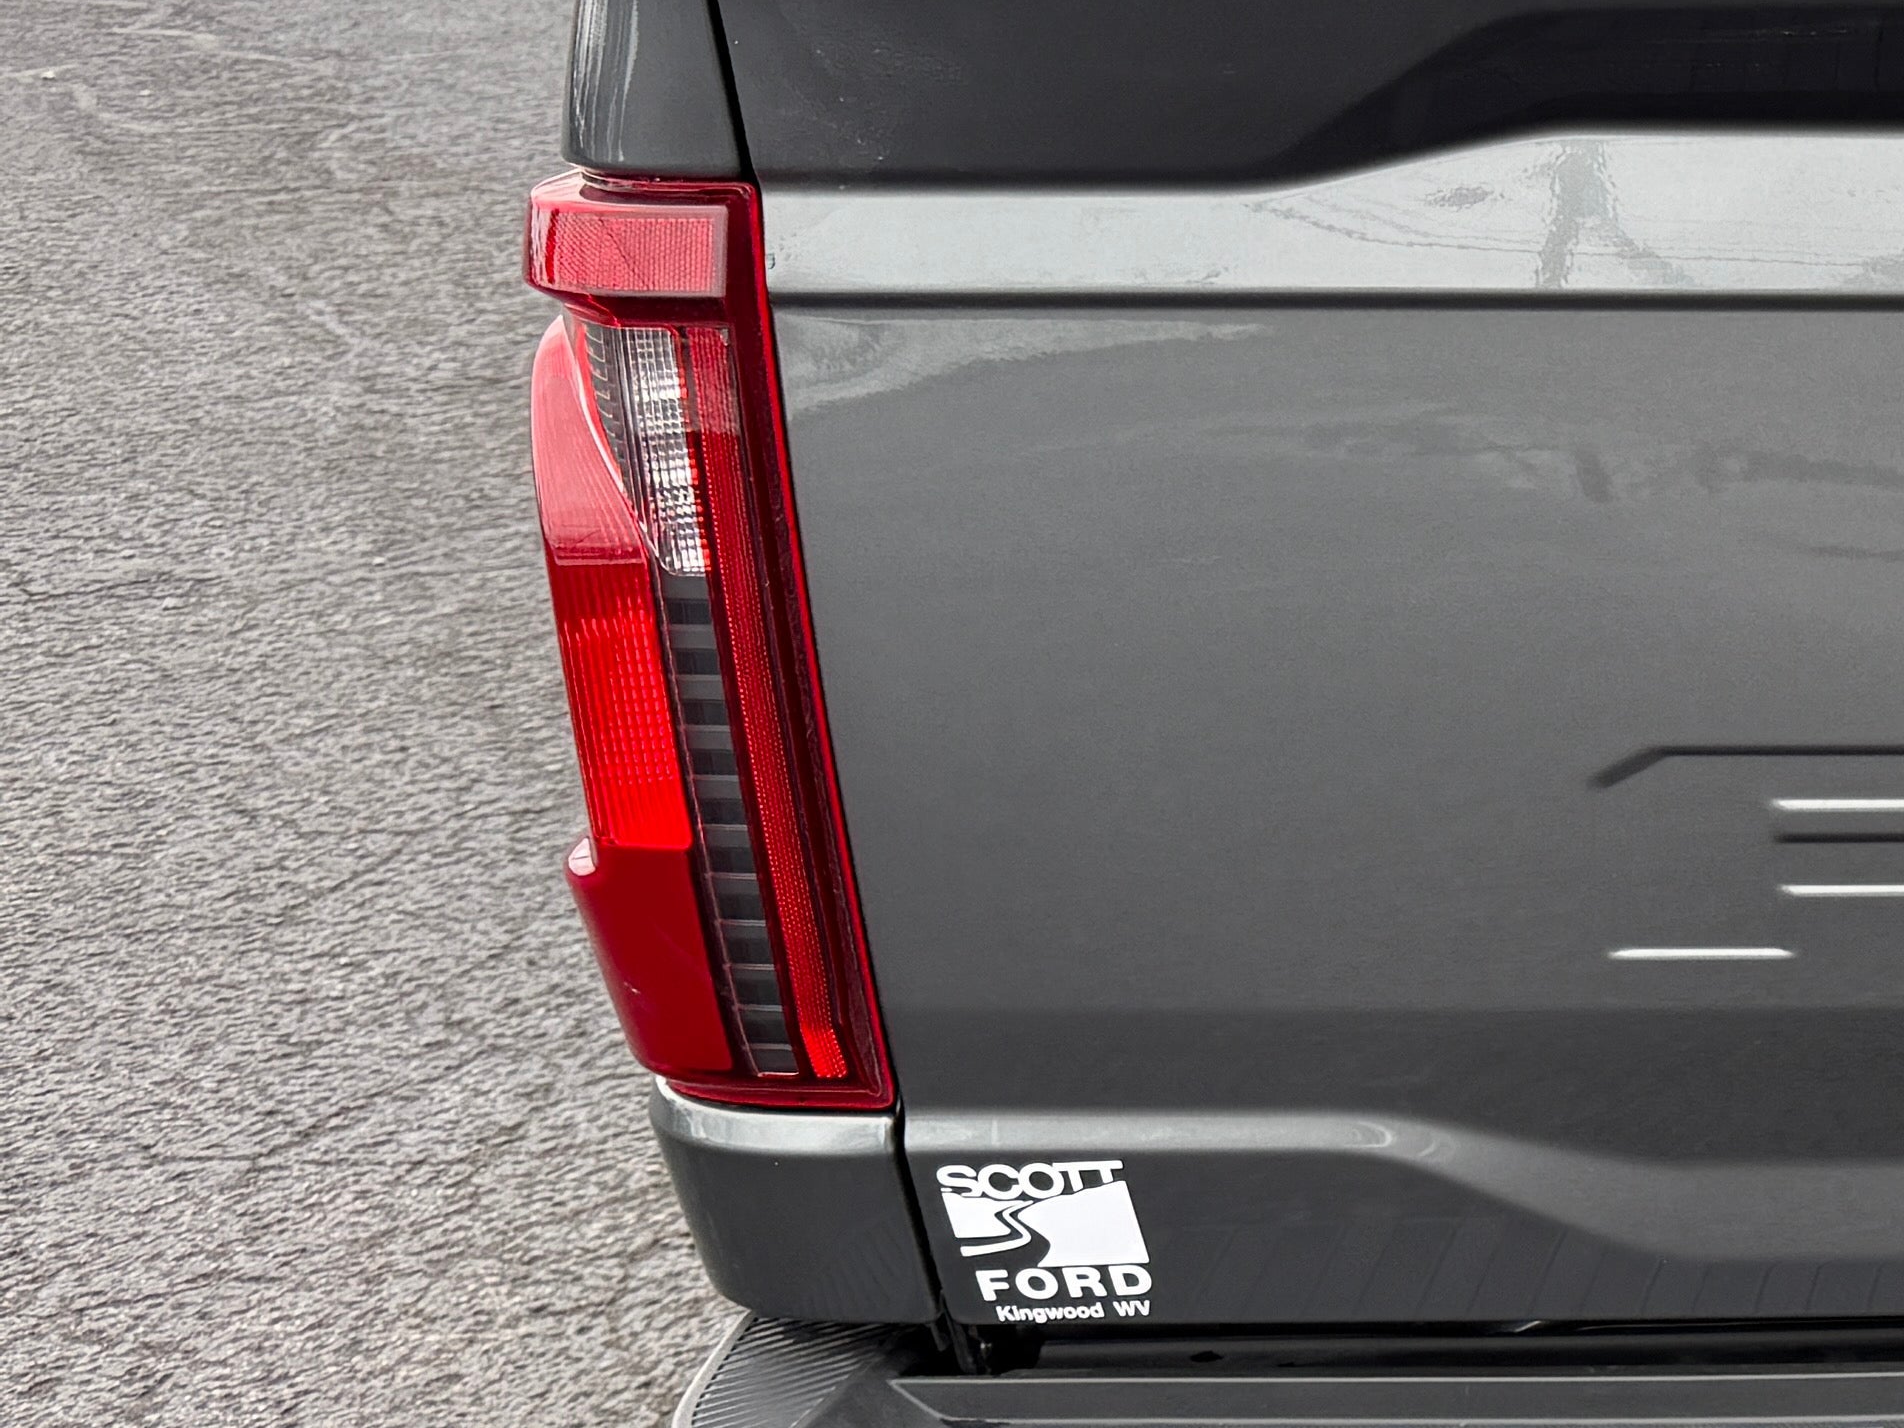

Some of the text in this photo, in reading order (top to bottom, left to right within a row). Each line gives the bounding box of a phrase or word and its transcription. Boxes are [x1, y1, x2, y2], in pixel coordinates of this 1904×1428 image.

[936, 1159, 1124, 1200] SCOTT
[975, 1264, 1152, 1301] FORD
[995, 1299, 1151, 1323] Kingwood WV
